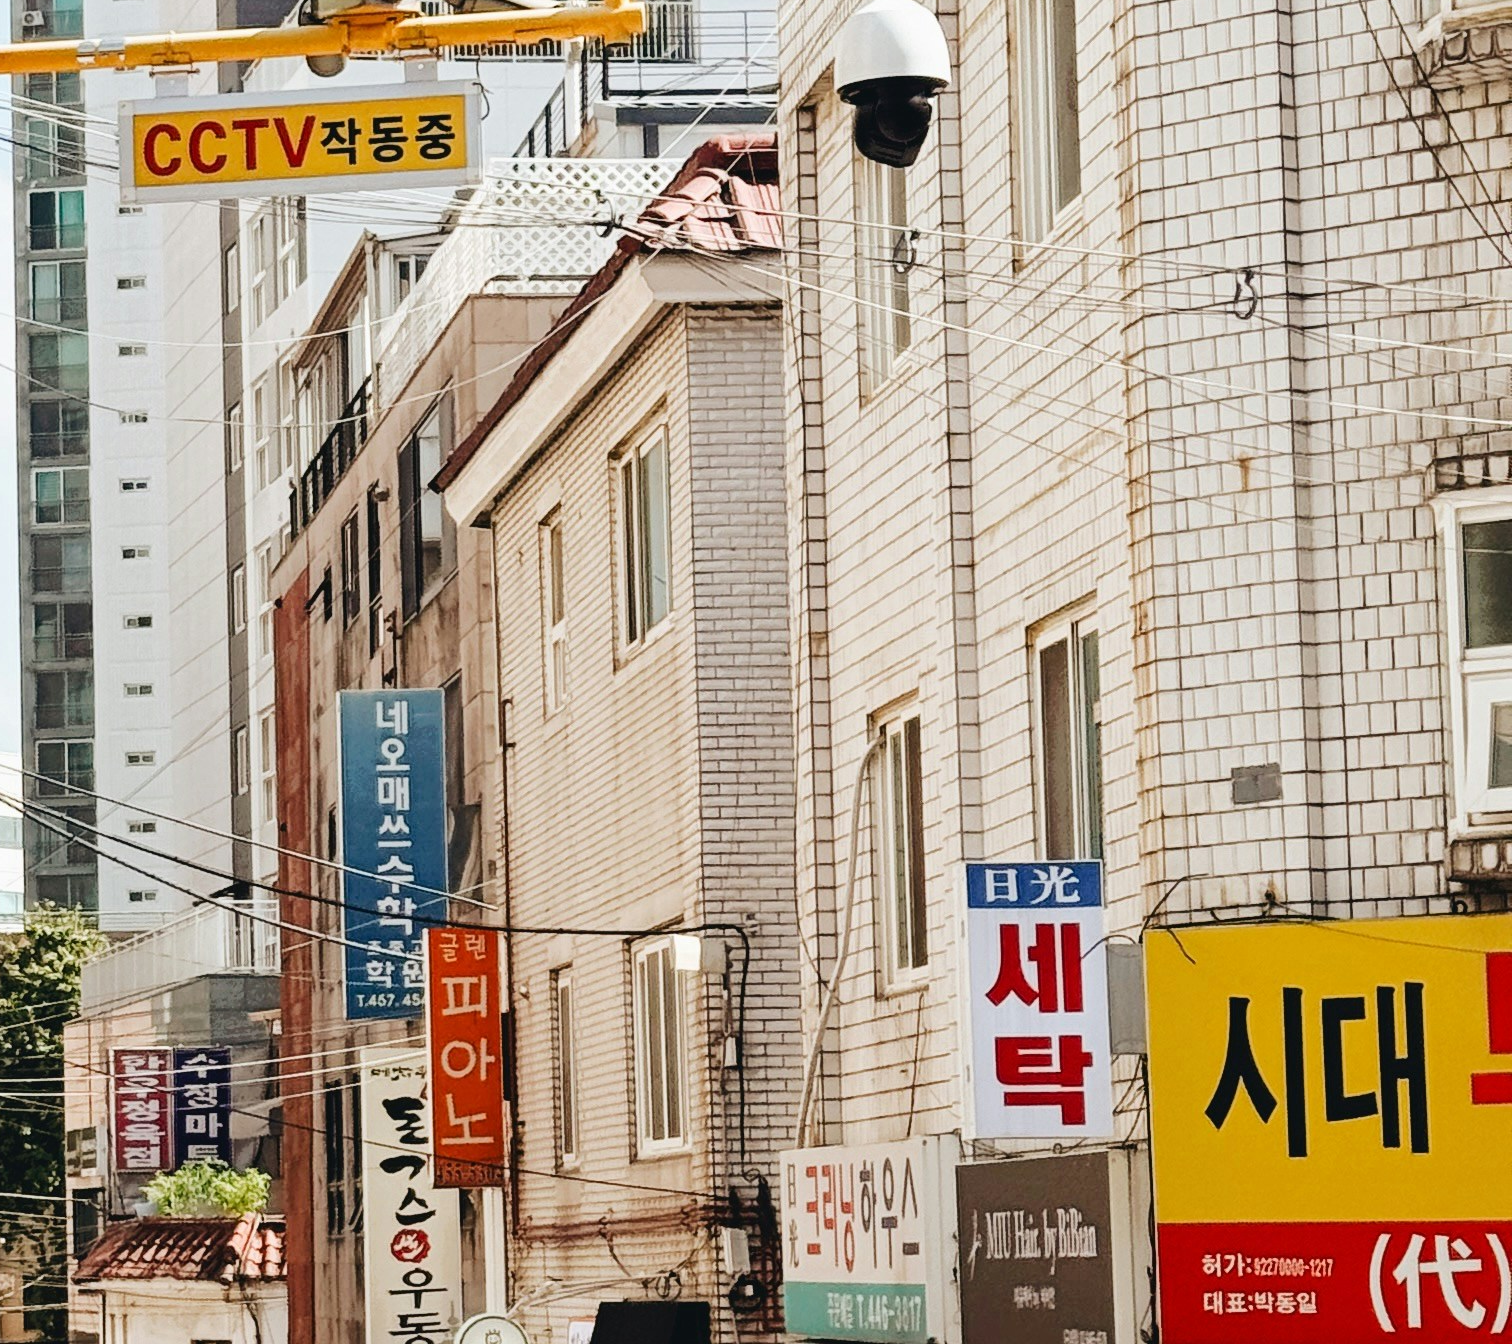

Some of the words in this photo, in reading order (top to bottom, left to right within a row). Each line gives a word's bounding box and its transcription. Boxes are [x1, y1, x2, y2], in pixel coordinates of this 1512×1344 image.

[144, 113, 456, 177] CCTV작동중
[375, 700, 418, 936] 네오매쓰수학
[985, 866, 1081, 905] 日光
[366, 960, 426, 989] 학원
[439, 932, 487, 963] 글렌
[356, 993, 426, 1008] T.457.45
[984, 922, 1094, 1126] 세탁
[441, 975, 496, 1145] 피아노
[1203, 981, 1430, 1158] 시대
[119, 1055, 166, 1168] 한우정육점
[985, 1210, 1011, 1259] MIU
[1042, 1207, 1057, 1276] by
[1202, 1290, 1318, 1316] 대표:박동일
